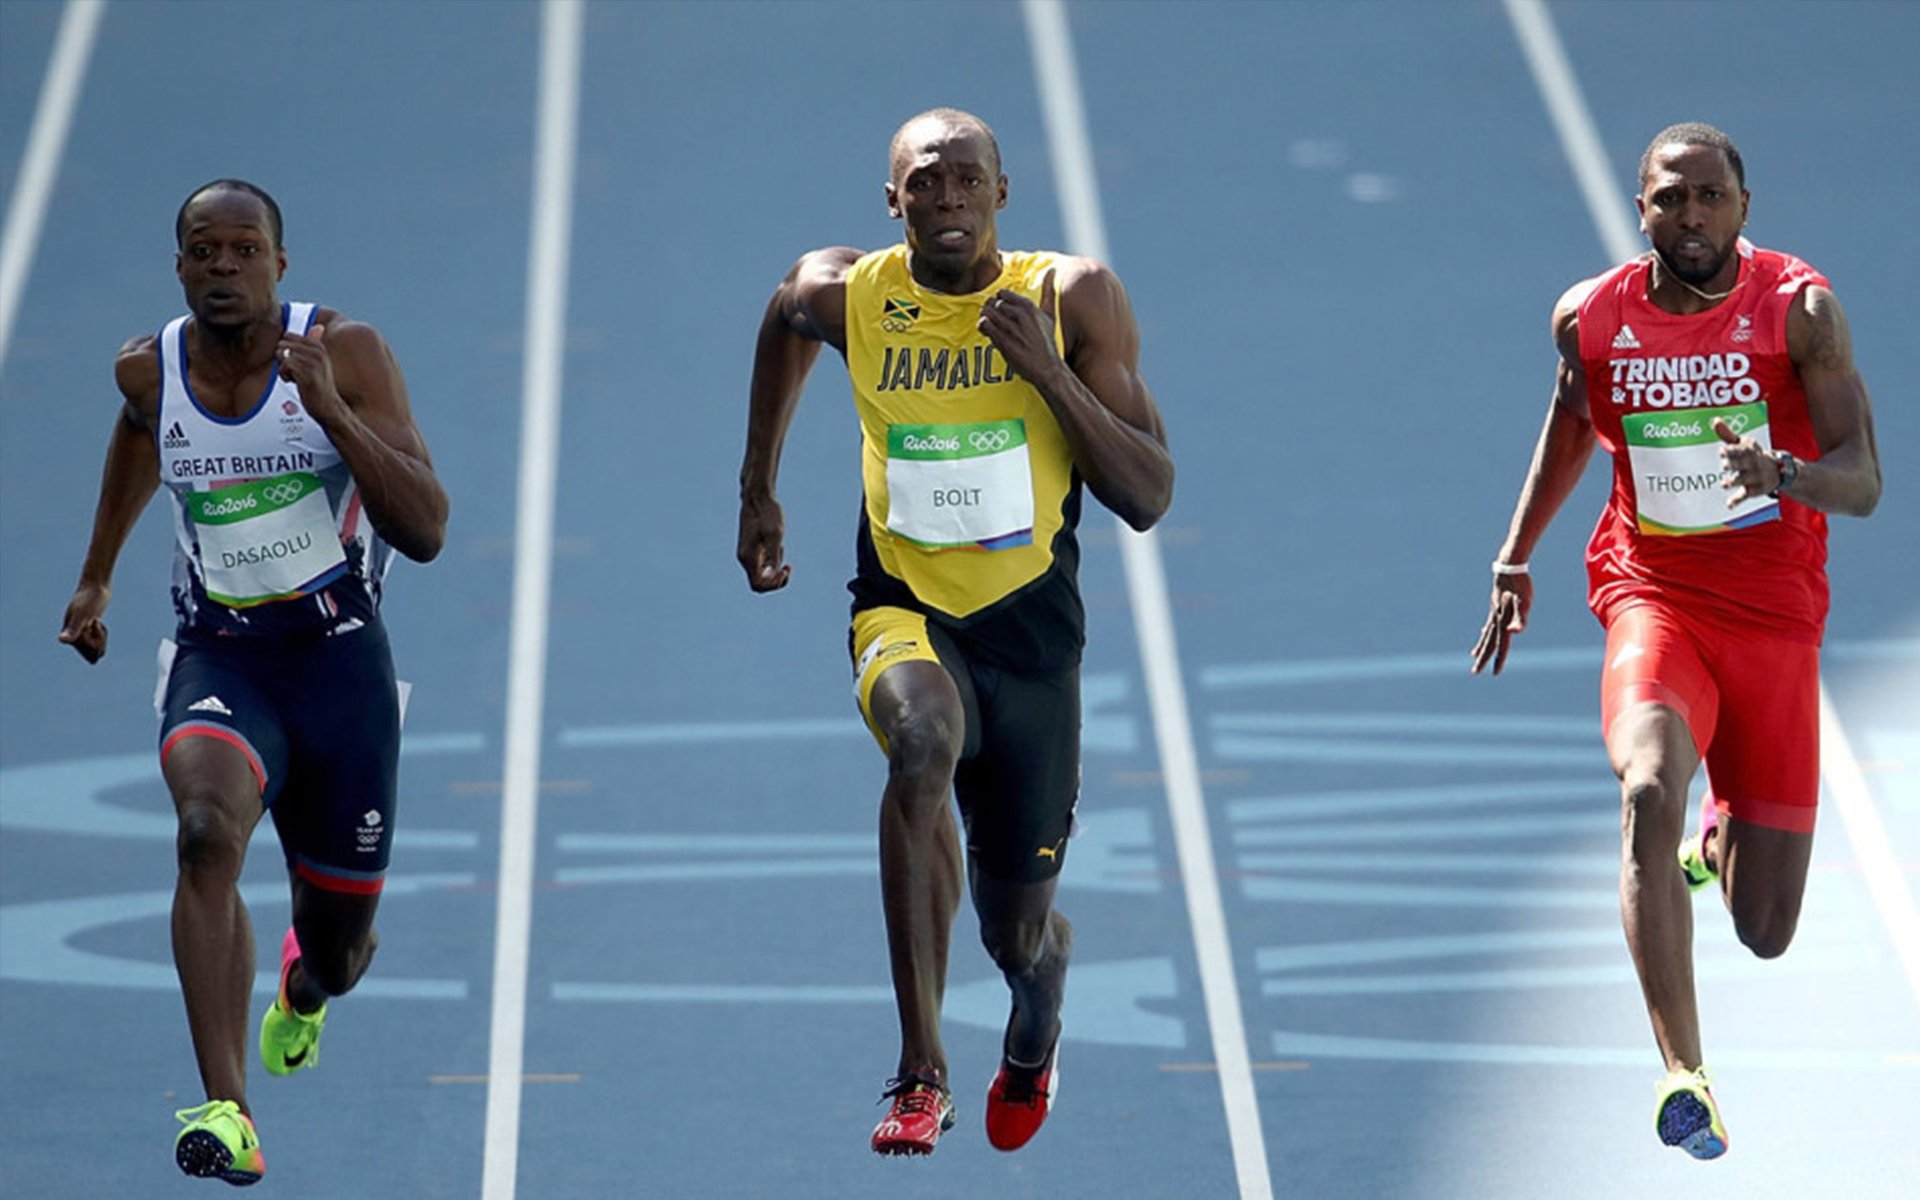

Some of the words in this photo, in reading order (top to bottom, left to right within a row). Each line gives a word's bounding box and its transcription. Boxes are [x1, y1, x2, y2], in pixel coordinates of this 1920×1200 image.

[877, 344, 1015, 392] JAMAIC
[1609, 352, 1750, 383] TRINIDAD
[1643, 421, 1702, 438] Rio2016
[903, 434, 960, 452] Rio2016
[172, 457, 225, 478] GREAT
[233, 452, 313, 474] BRITAIN
[202, 494, 257, 516] Rio2016
[933, 489, 982, 508] BOLT
[221, 532, 312, 569] DASAOLU
